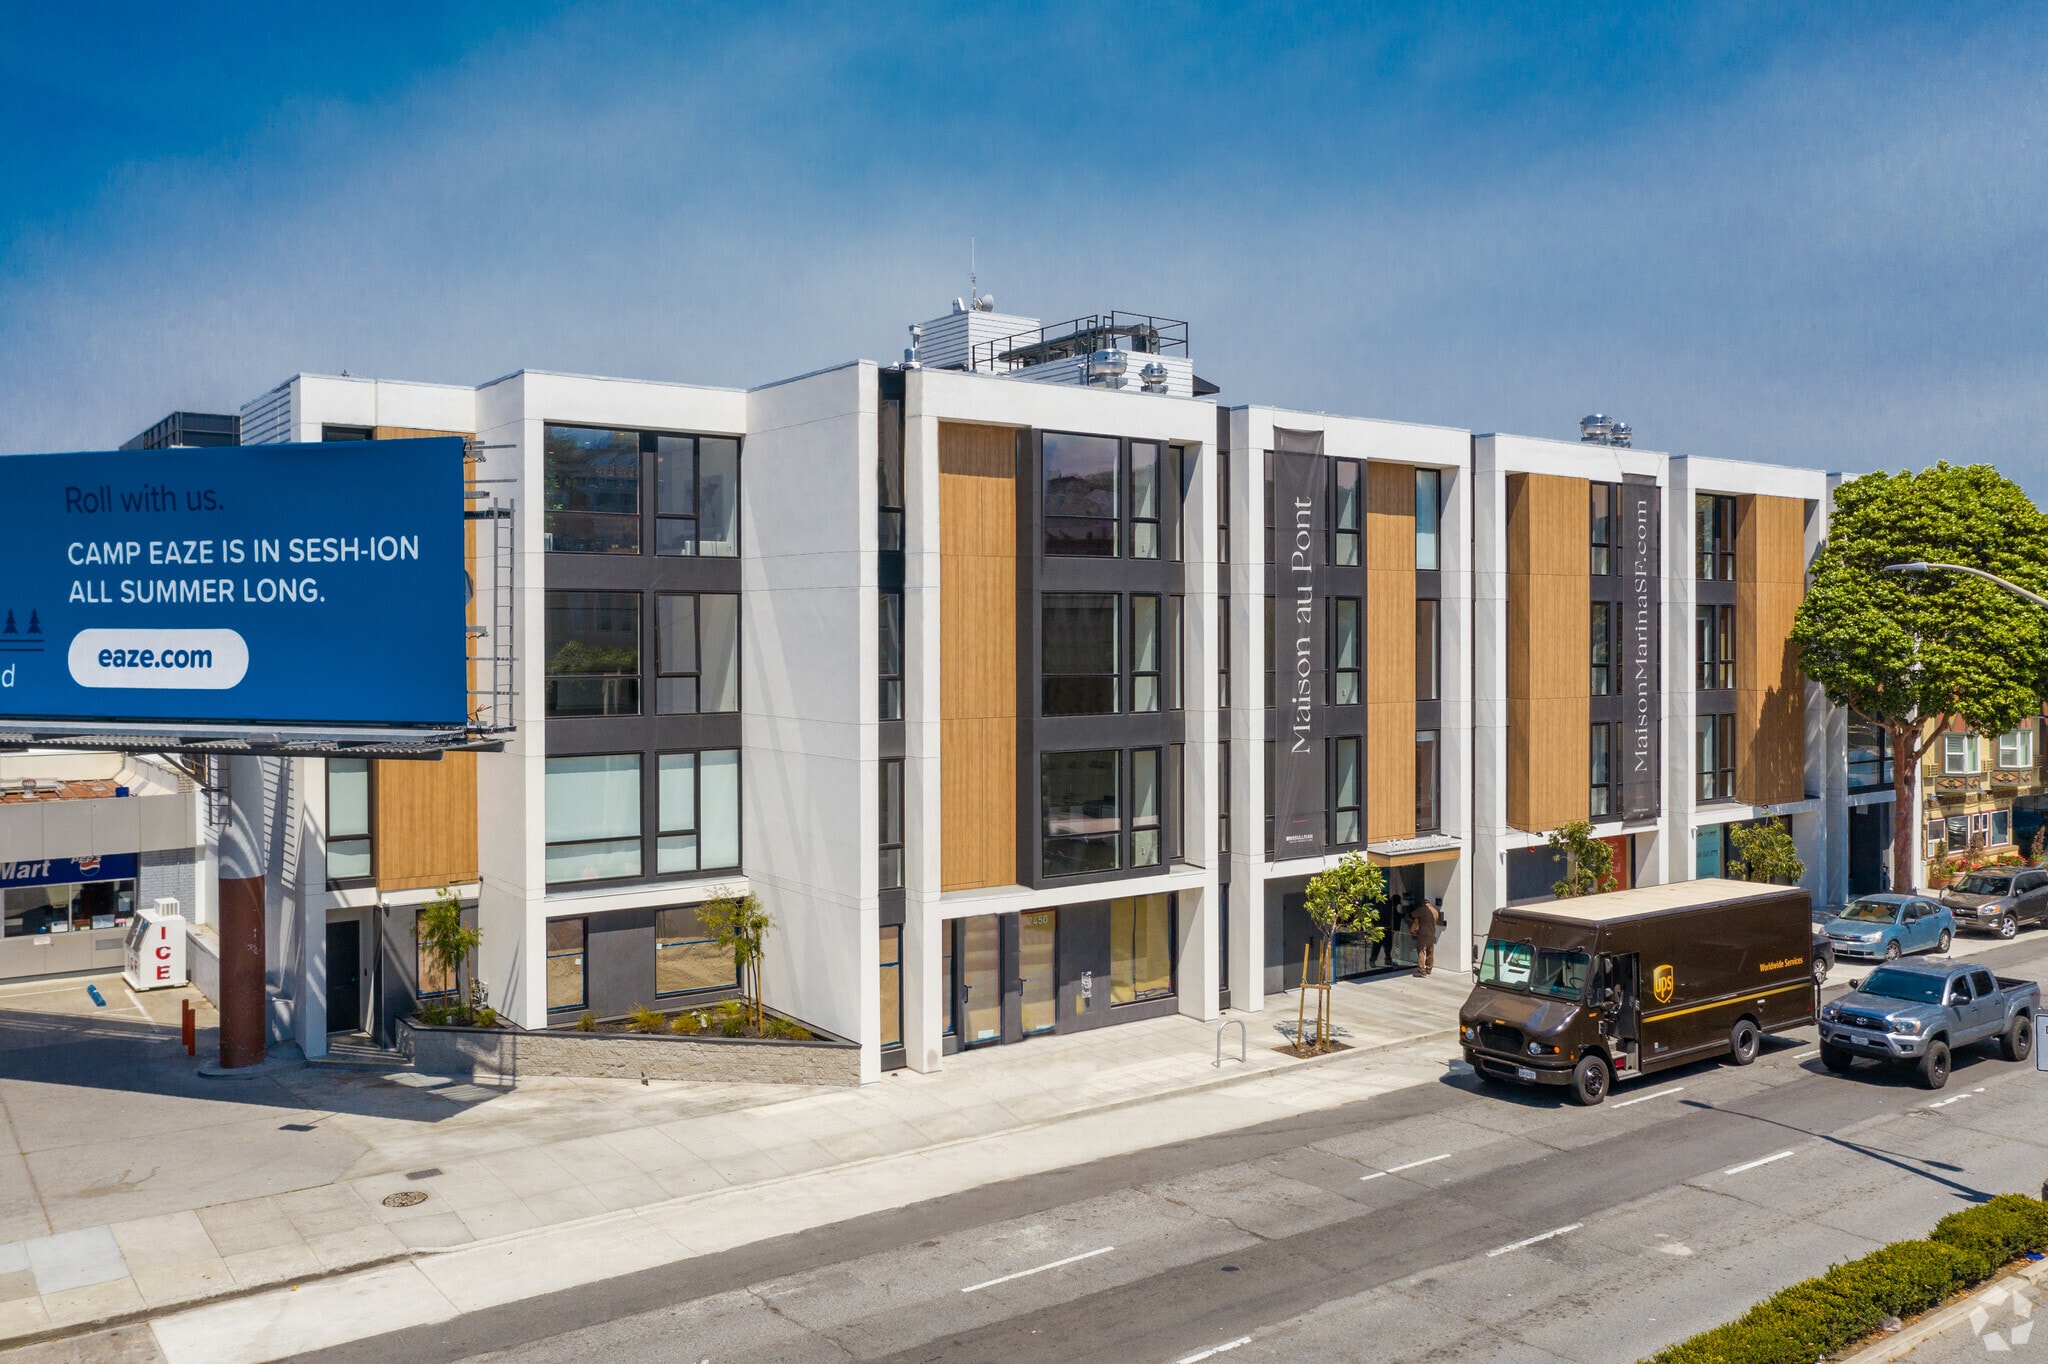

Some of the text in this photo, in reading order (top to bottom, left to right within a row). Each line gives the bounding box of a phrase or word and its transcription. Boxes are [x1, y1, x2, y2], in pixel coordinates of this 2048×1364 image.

[65, 484, 225, 513] Roll with us.
[67, 535, 419, 565] CAMP EAZE IS IN SESH-ION
[69, 577, 326, 604] ALL SUMMER LONG.
[1291, 496, 1313, 754] Maison au Pont
[1634, 499, 1648, 773] MaisonMarinaSF.com
[98, 646, 213, 669] eaze.com
[0, 860, 51, 880] Mart
[155, 926, 171, 980] ICE
[1759, 957, 1803, 972] Worldwide Services
[1655, 975, 1672, 998] ups
